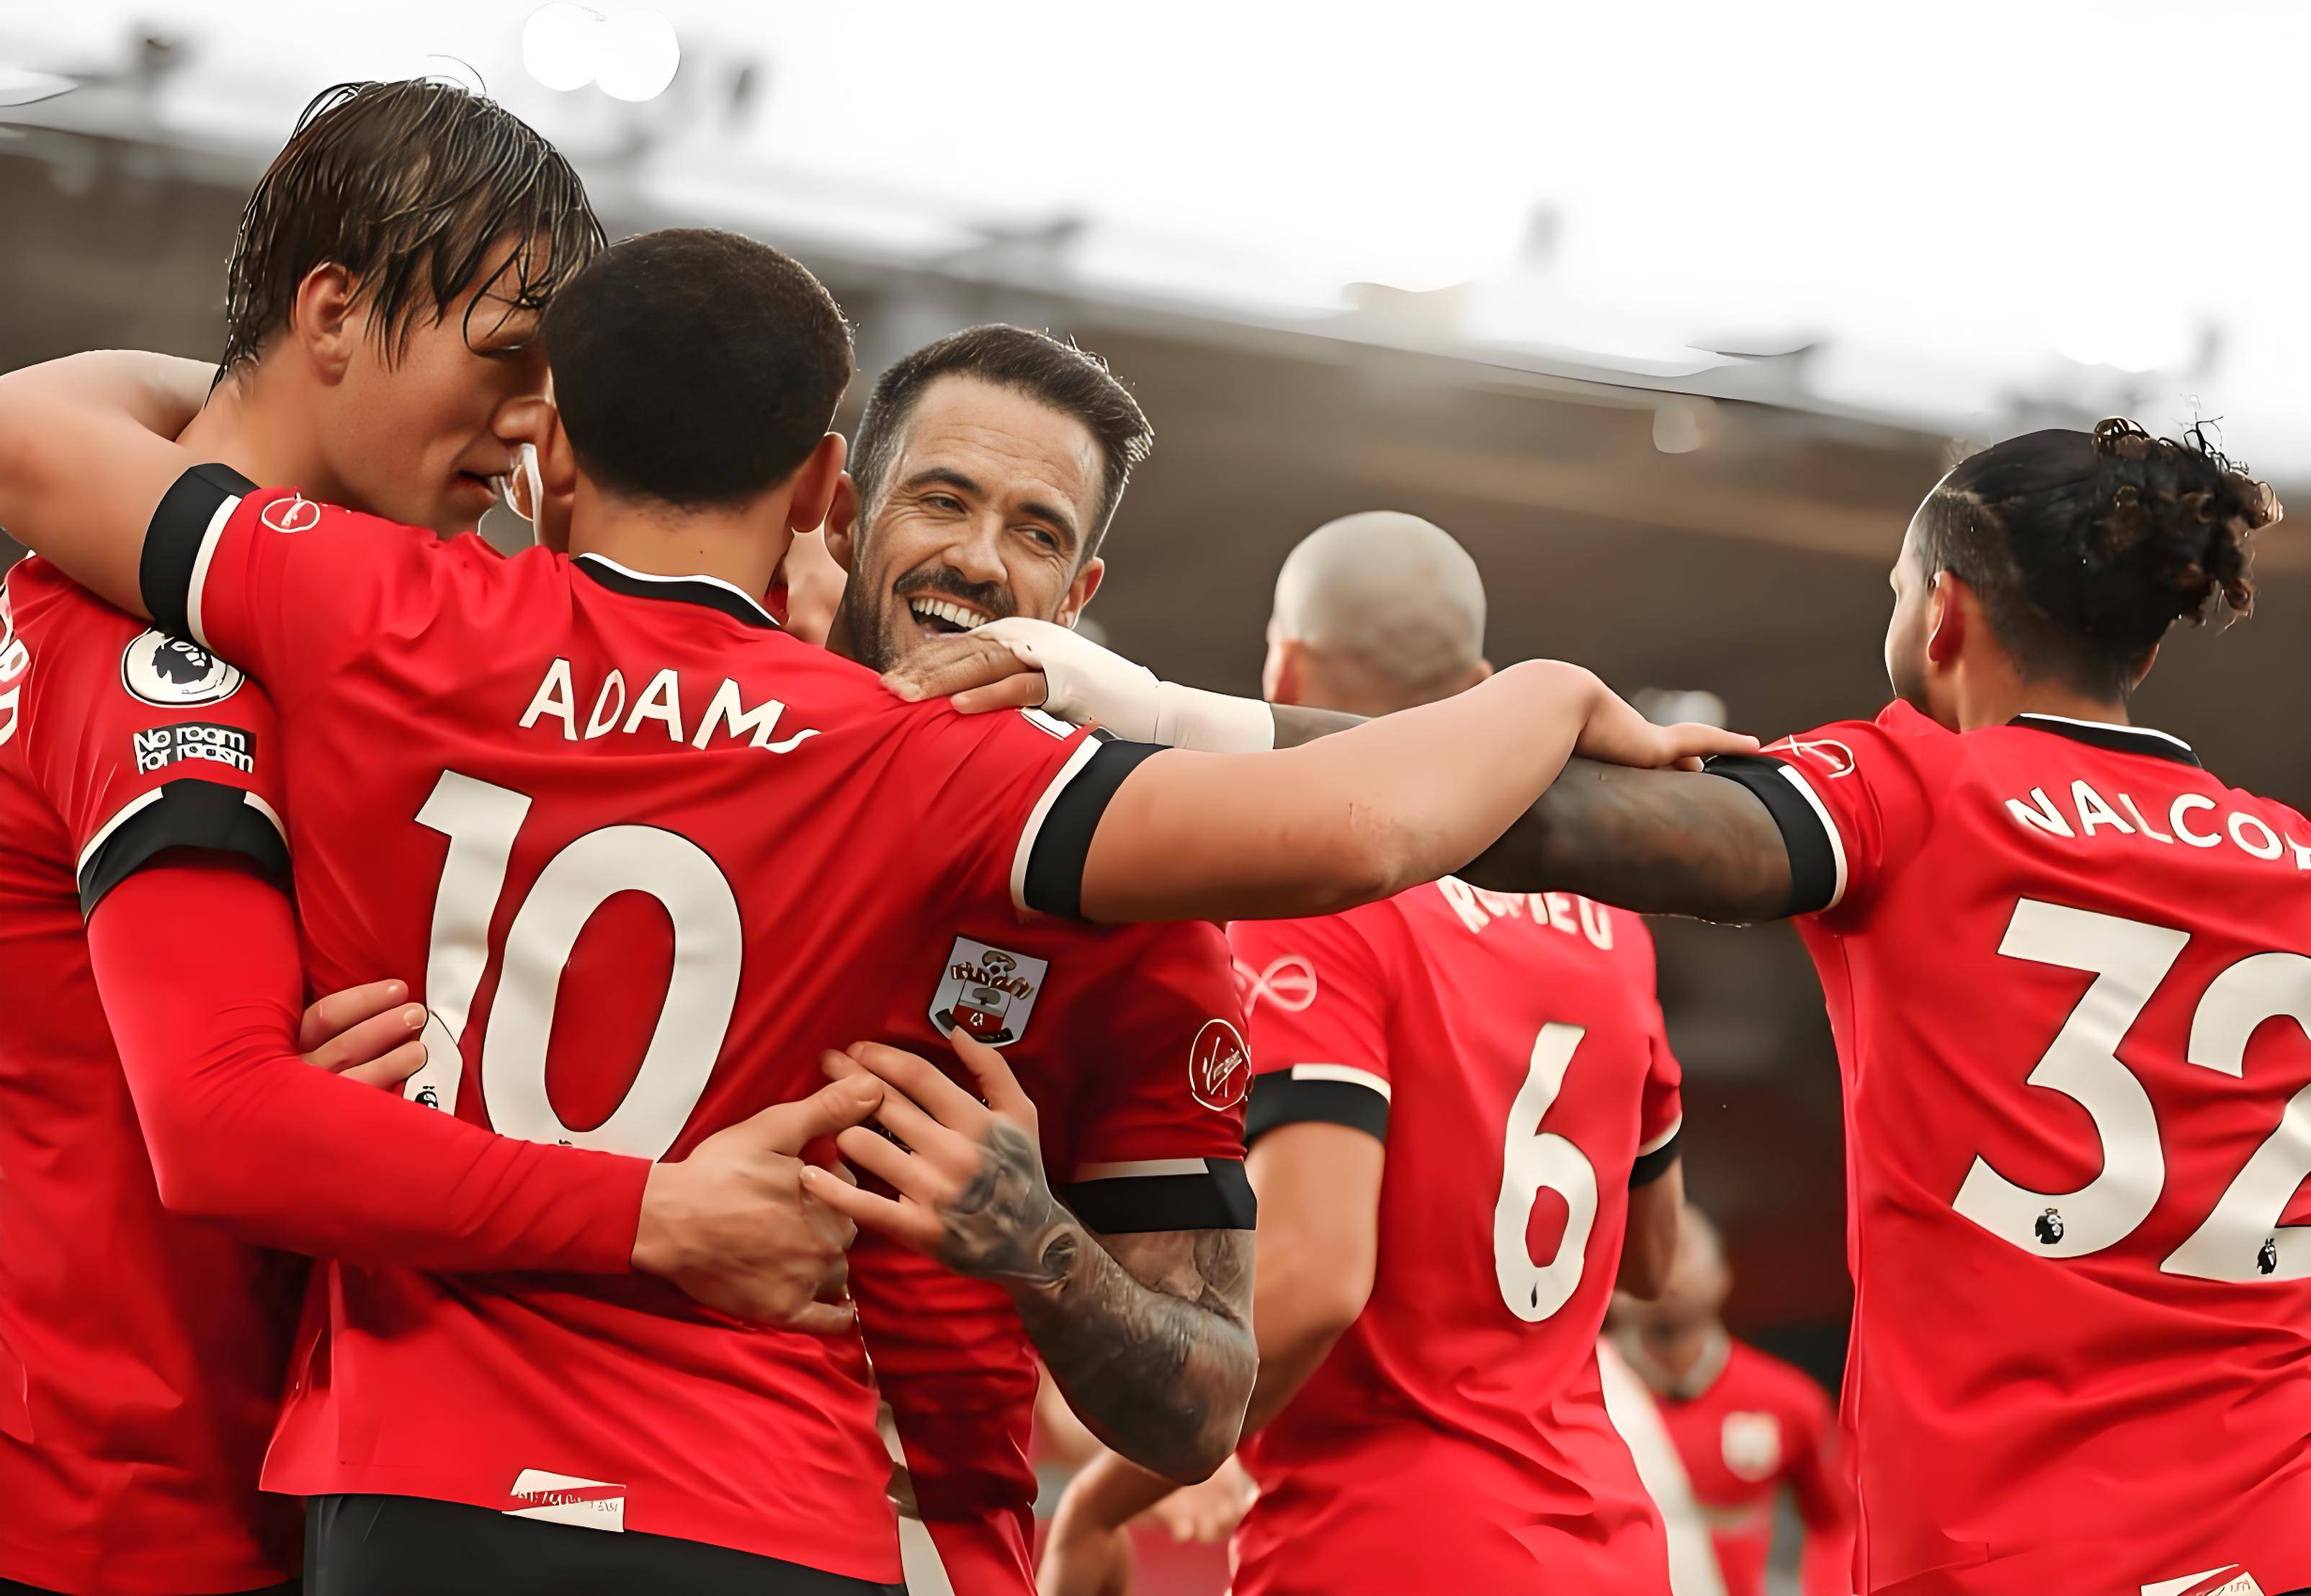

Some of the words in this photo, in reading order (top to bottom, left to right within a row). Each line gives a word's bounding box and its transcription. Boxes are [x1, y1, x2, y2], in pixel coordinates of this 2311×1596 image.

[133, 729, 171, 752] No
[176, 726, 246, 752] room
[519, 656, 821, 754] ADAM
[403, 769, 743, 1162] 10
[1952, 897, 2311, 1284] 32
[1493, 1021, 1599, 1322] 6
